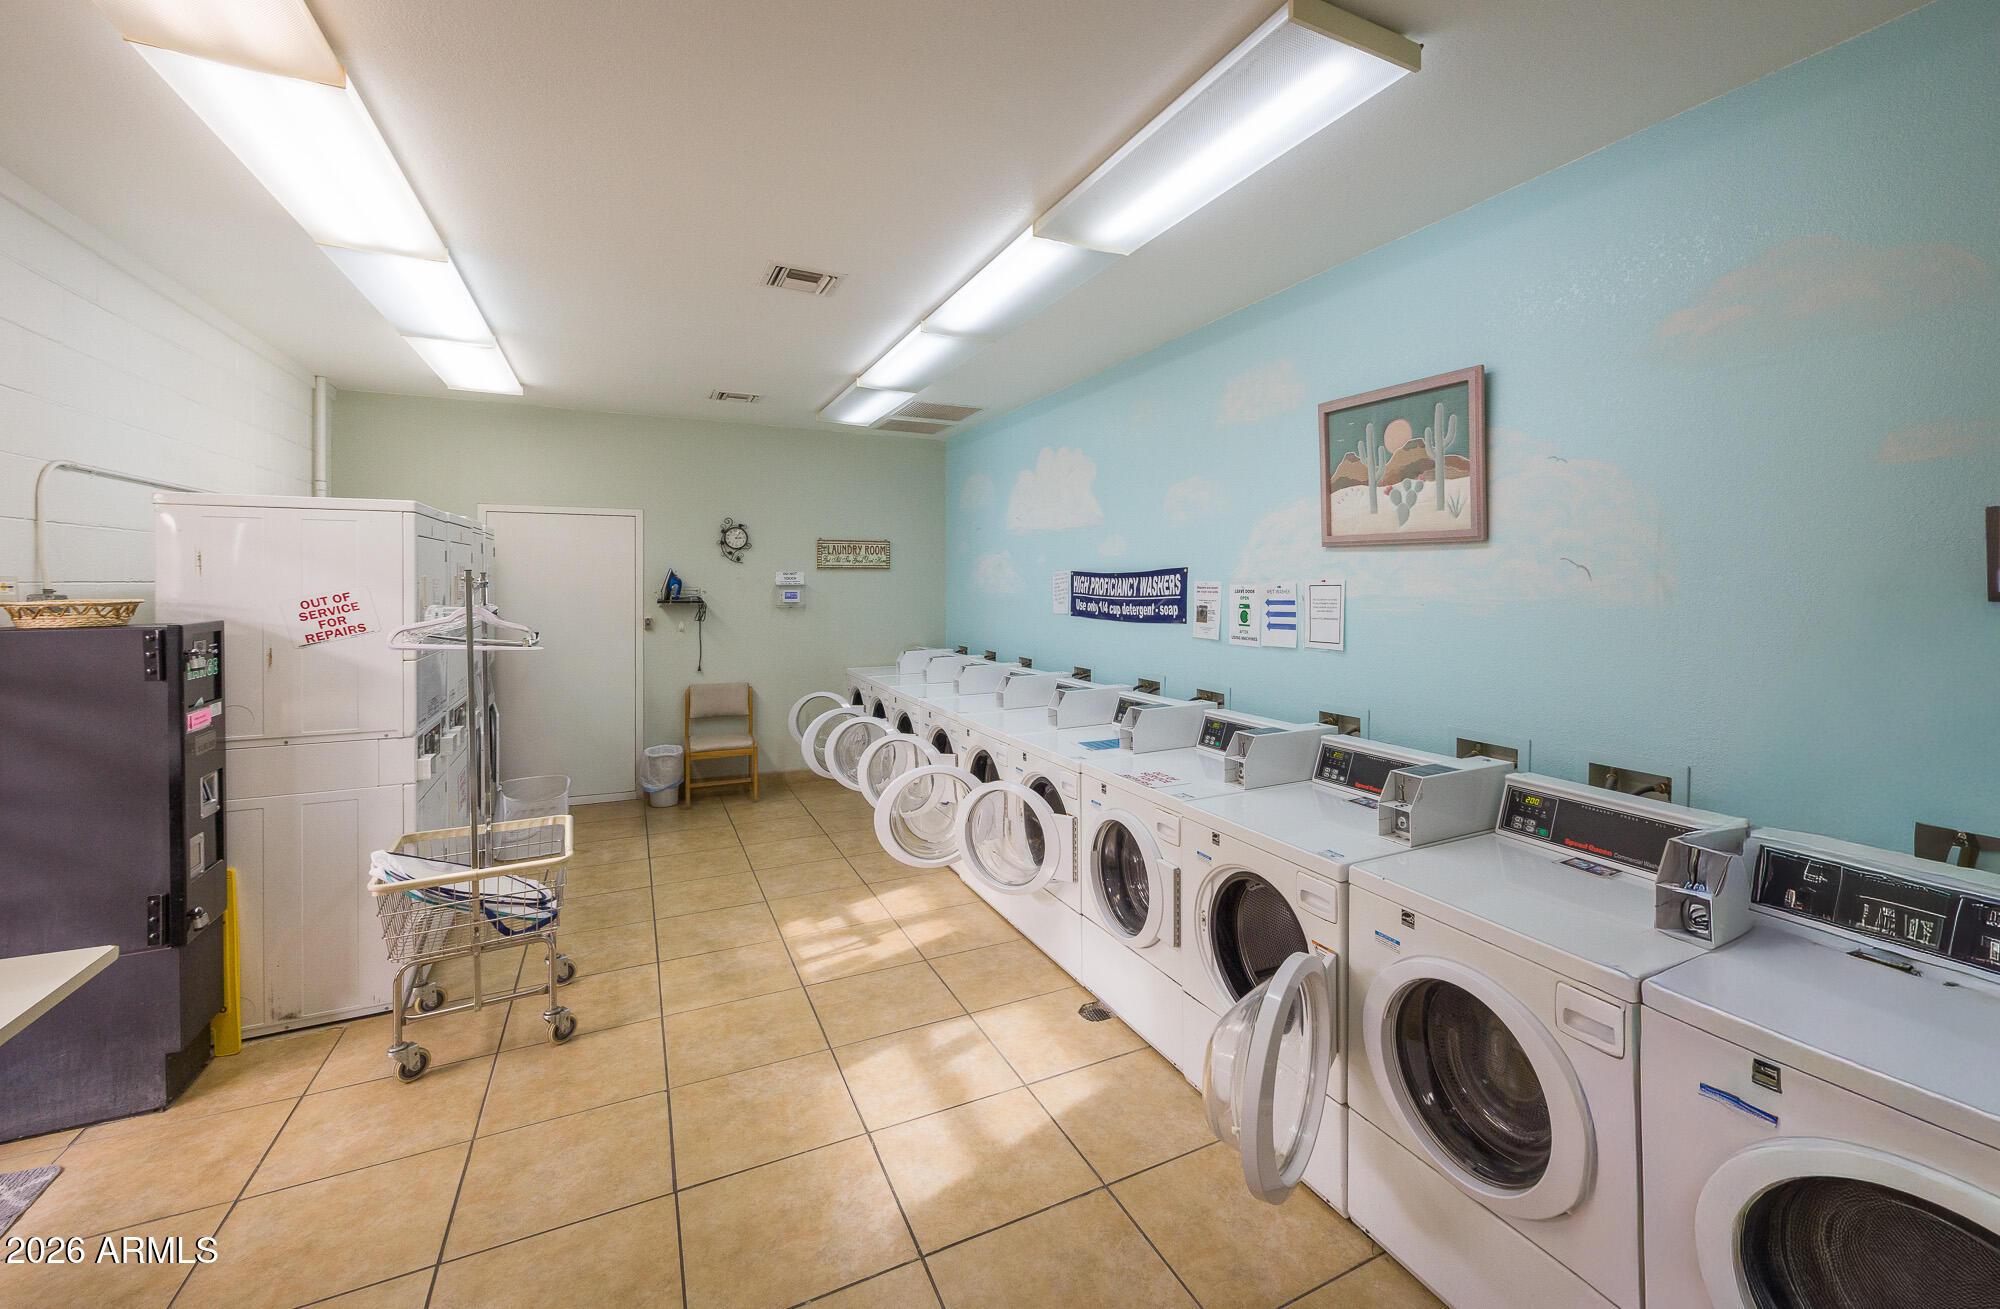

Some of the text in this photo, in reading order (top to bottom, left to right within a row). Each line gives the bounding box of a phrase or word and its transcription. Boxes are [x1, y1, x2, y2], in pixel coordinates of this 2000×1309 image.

[827, 544, 863, 555] LAUNDRY
[865, 545, 886, 555] ROOM
[1073, 575, 1090, 594] HIGH
[1089, 576, 1139, 597] PROFICIANCY
[1139, 574, 1181, 597] WASHERS
[300, 592, 350, 609] OUT OF
[1075, 599, 1087, 611] Use
[1087, 601, 1099, 615] only
[1099, 600, 1108, 614] 1/4
[1109, 604, 1121, 617] cup
[1122, 602, 1155, 619] detergent
[1159, 604, 1179, 618] soap
[298, 601, 360, 621] SERVICE
[318, 616, 347, 629] FOR
[304, 623, 367, 643] REPAIRS
[1525, 796, 1540, 806] 200
[1564, 837, 1588, 850] Speed
[1588, 844, 1613, 857] Queen
